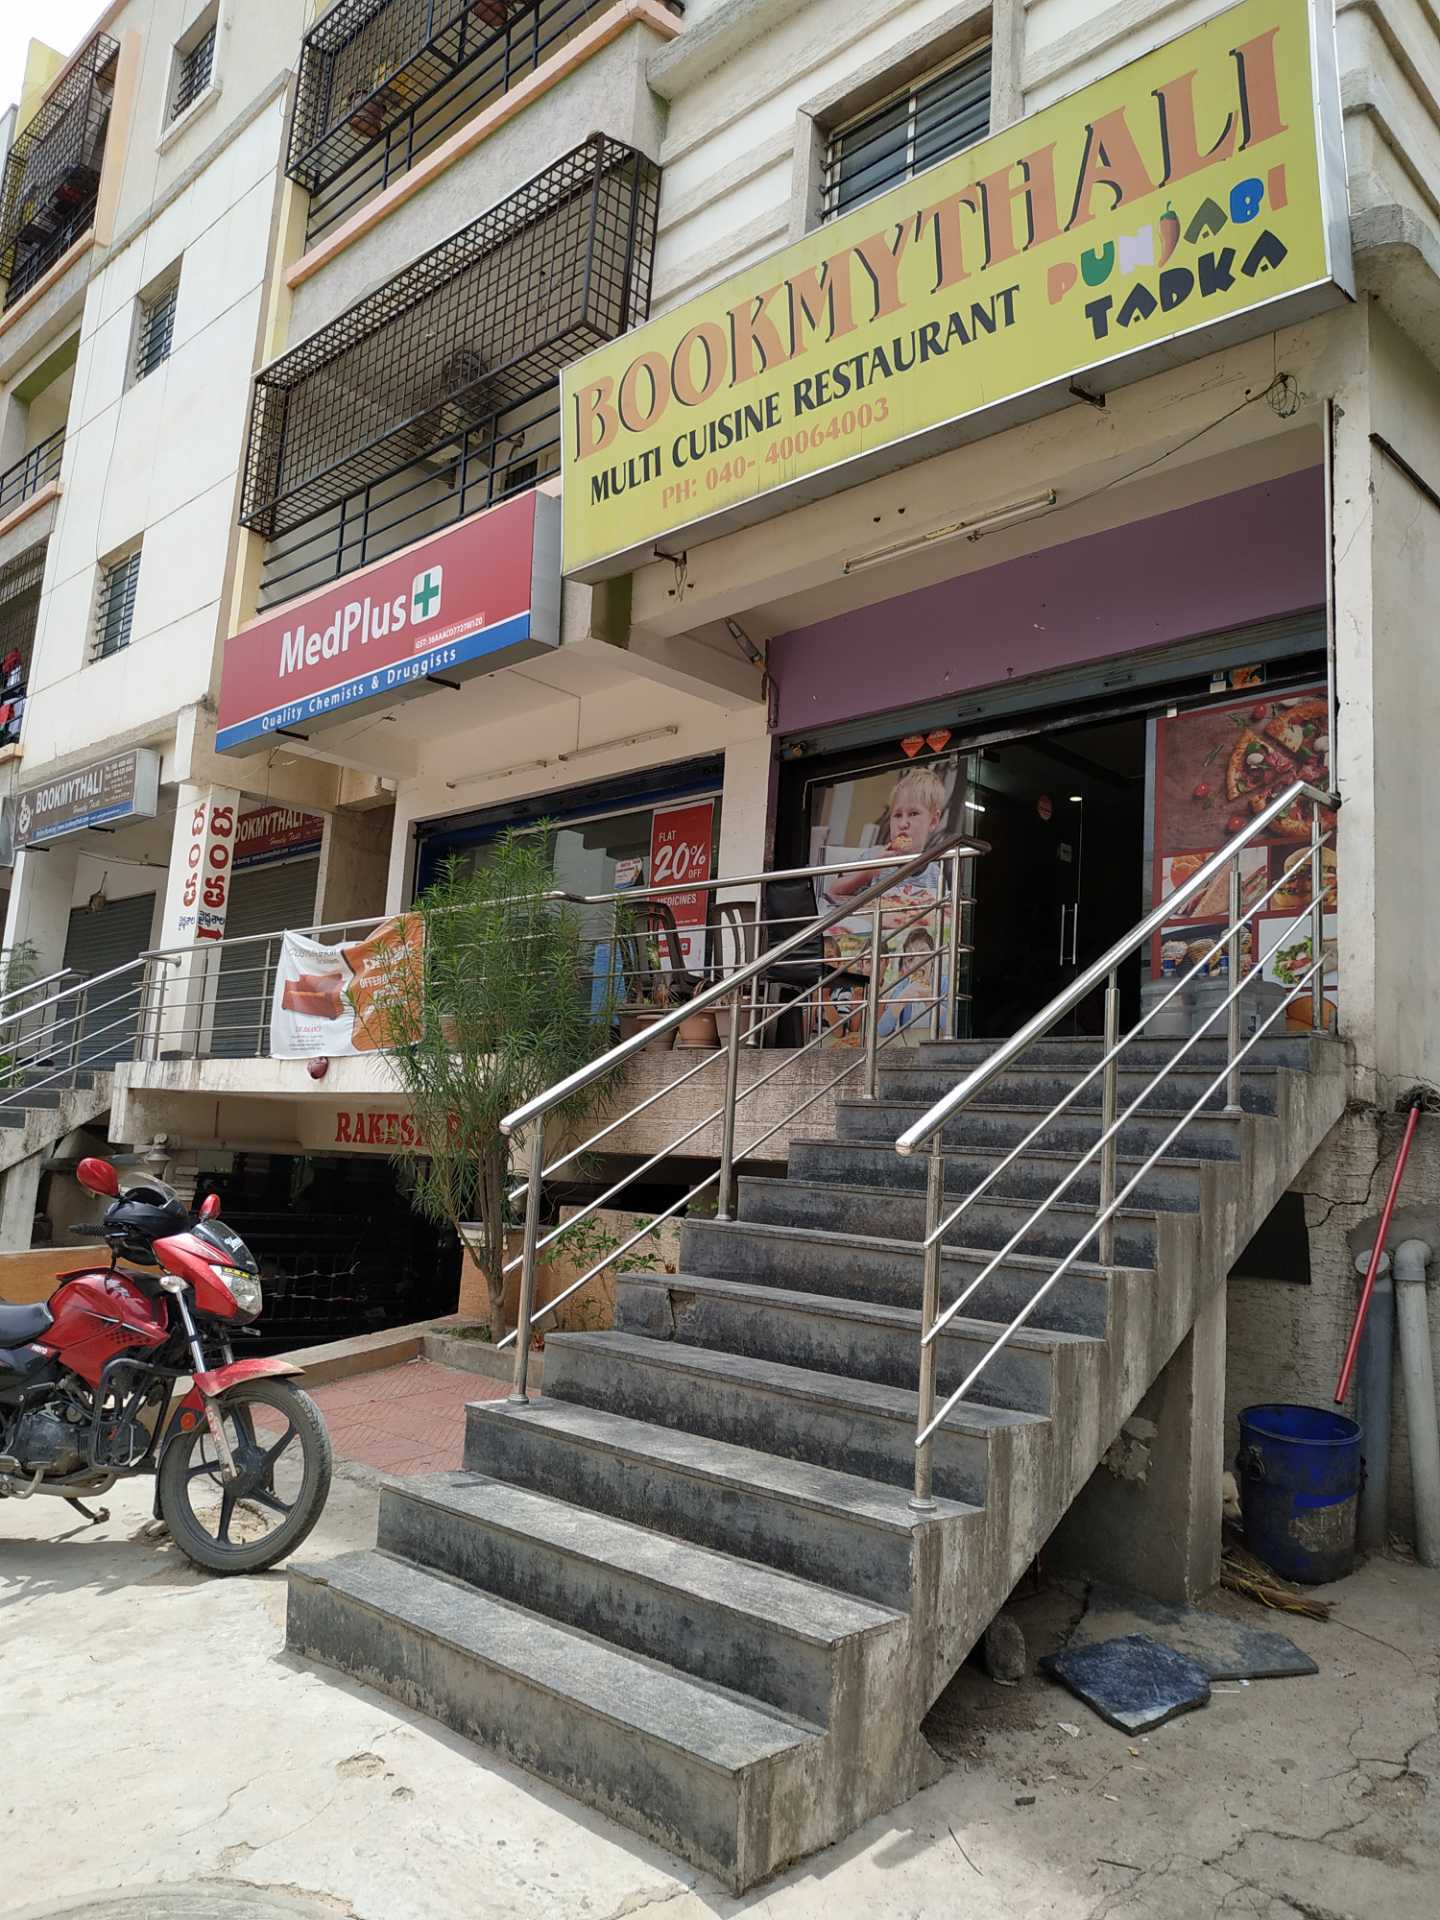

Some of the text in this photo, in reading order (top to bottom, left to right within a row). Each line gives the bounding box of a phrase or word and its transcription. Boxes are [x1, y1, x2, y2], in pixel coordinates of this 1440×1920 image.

[574, 26, 1289, 463] BOOKMYTHALI
[1046, 164, 1288, 306] PUNJABI
[1085, 229, 1288, 341] TADKA
[590, 284, 1020, 507] MULTI CUISINE RESTAURANT
[660, 473, 698, 510] PH:
[764, 397, 890, 467] 40064003
[278, 594, 406, 677] MedPlus
[262, 649, 457, 730] Quality Chemists & Druggists
[36, 769, 103, 815] BOOKMYTHALI
[235, 809, 304, 844] OOKMYTHALI
[654, 841, 706, 883] 20%
[659, 830, 676, 842] FLAT
[688, 868, 703, 880] OFF
[334, 1112, 425, 1147] RAKES
